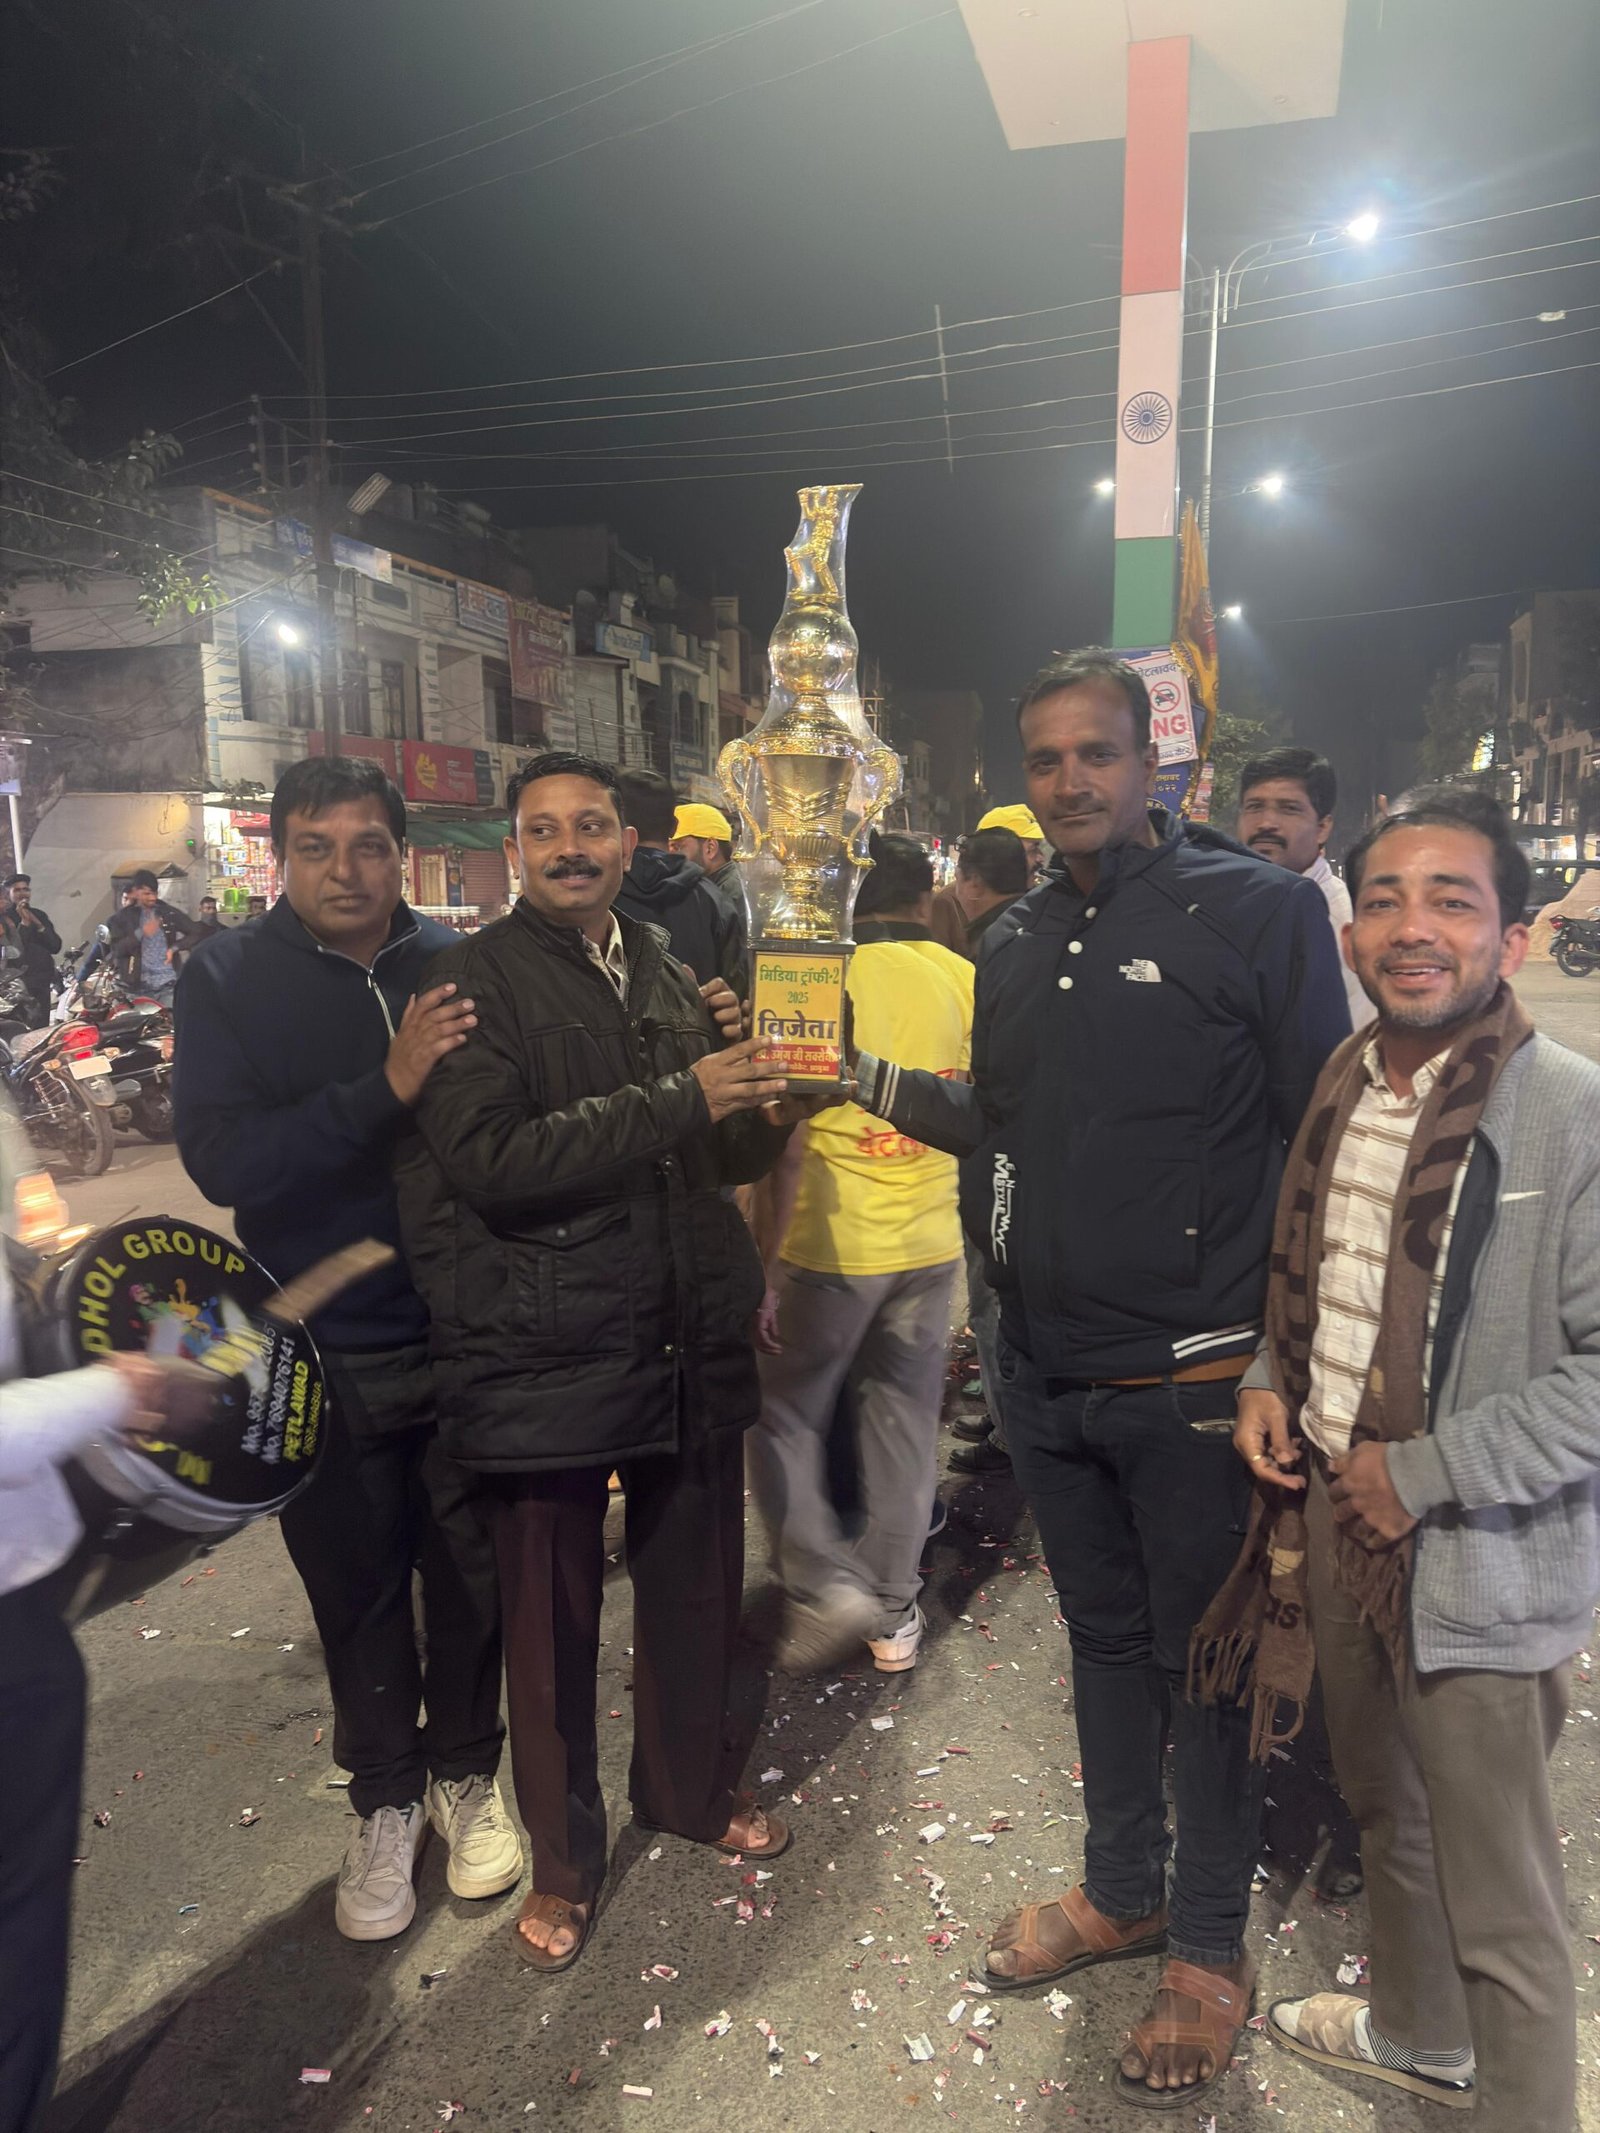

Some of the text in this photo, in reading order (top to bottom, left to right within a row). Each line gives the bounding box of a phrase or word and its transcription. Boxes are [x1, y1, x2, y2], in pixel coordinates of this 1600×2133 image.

[760, 964, 798, 982] मिडिया
[787, 991, 808, 1004] 2025
[758, 1009, 837, 1039] विजेता
[792, 1047, 803, 1061] जी
[79, 1229, 246, 1353] DHOL GROUP
[283, 1360, 308, 1462] PETLAWAD
